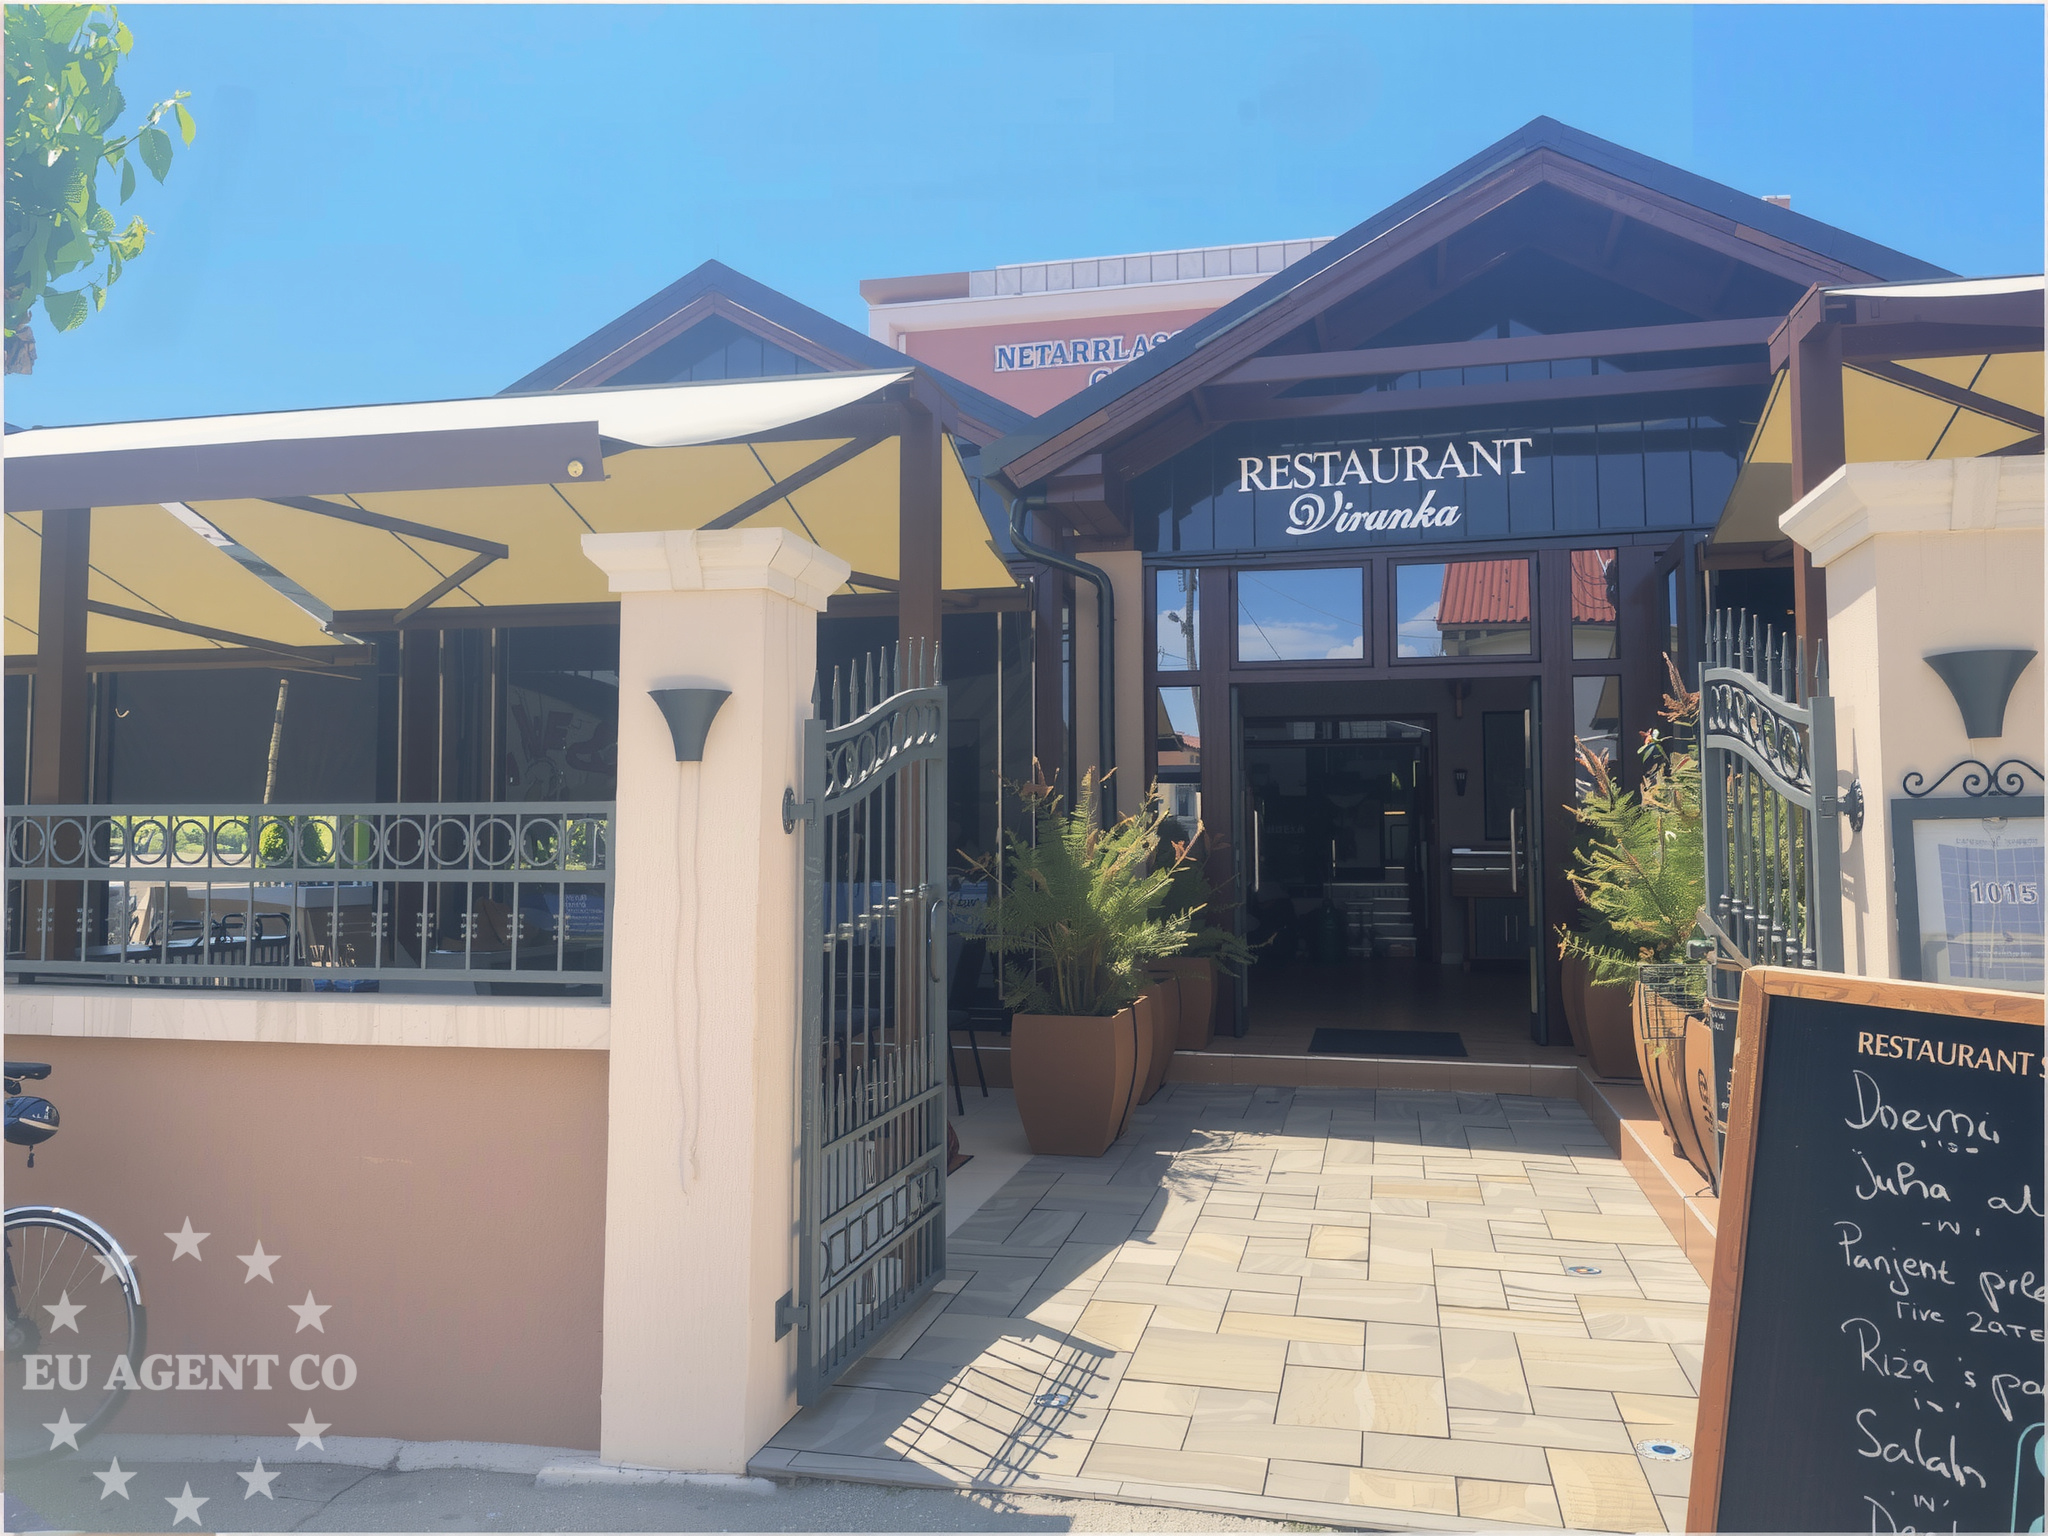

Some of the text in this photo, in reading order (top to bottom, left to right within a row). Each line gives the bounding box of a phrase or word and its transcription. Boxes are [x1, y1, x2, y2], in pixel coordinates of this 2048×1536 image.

[1238, 438, 1533, 492] RESTAURANT
[1285, 489, 1462, 536] Viranka
[1970, 880, 2039, 905] 1015
[1857, 1030, 2035, 1076] RESTAURANT
